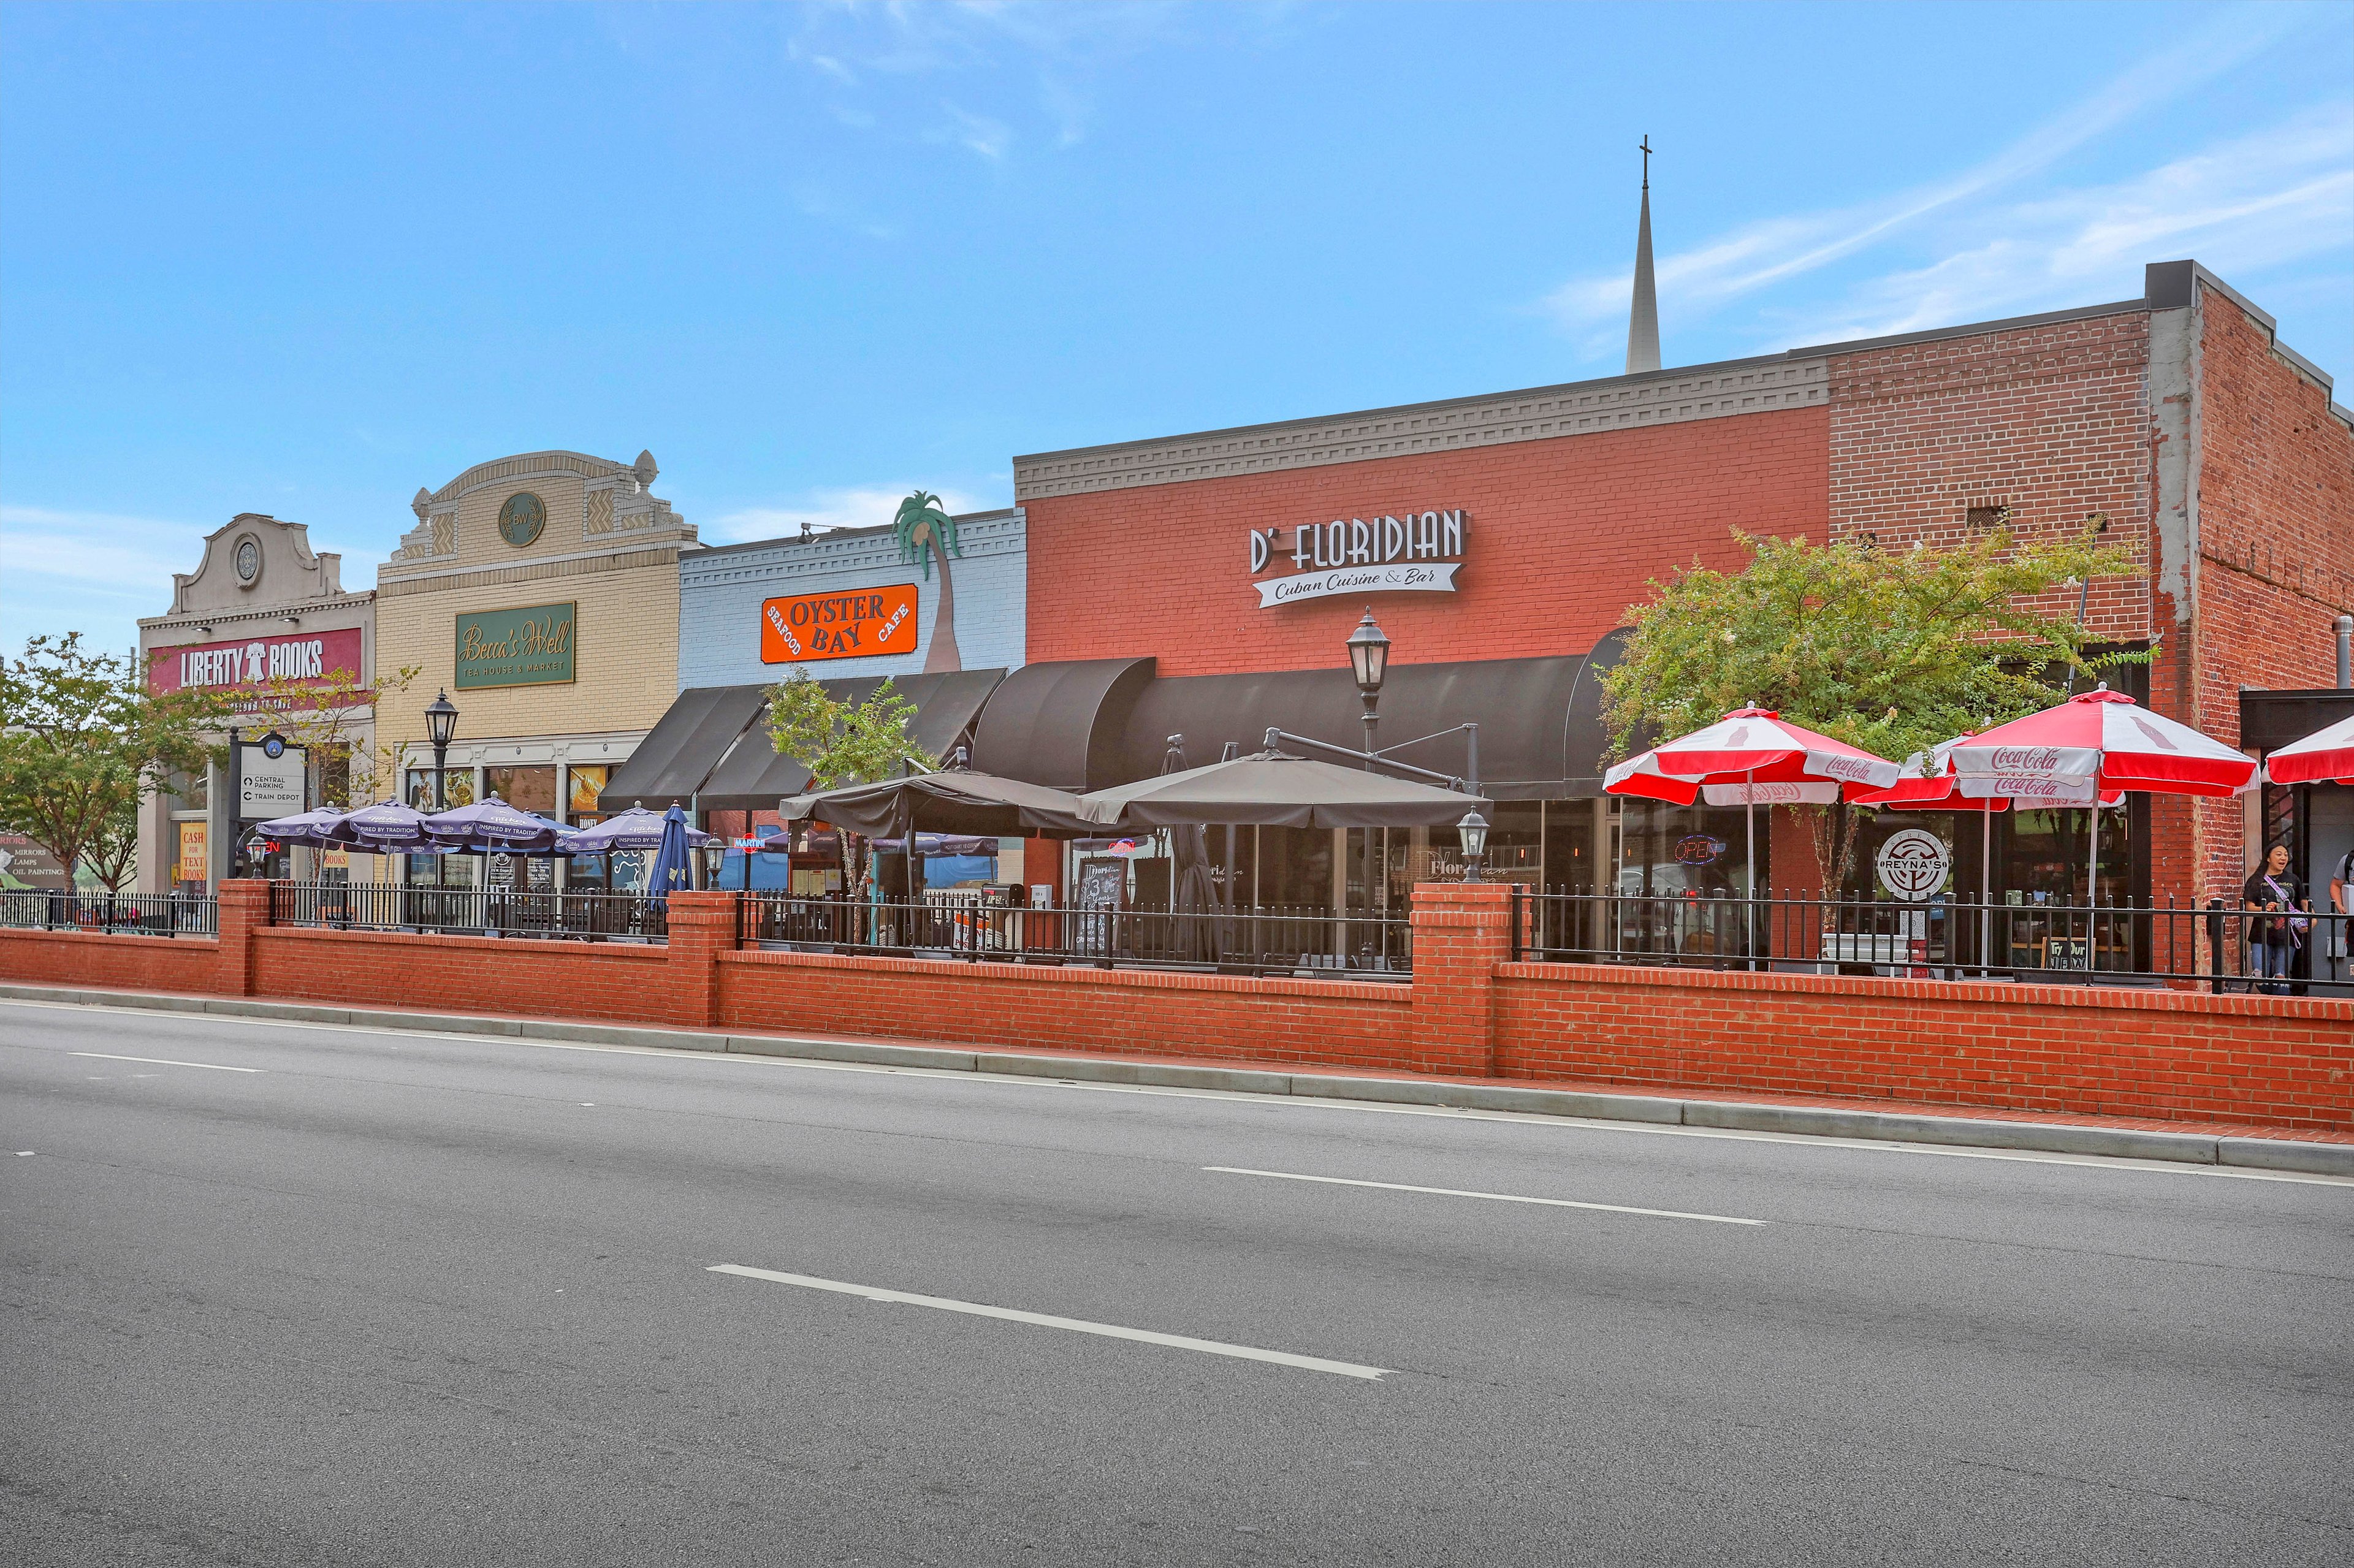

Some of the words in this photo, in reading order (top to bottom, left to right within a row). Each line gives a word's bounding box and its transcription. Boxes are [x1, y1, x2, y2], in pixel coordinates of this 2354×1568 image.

[514, 513, 528, 525] BW
[1290, 509, 1463, 569] FLORIDIAN
[1275, 582, 1323, 599] Cuban
[1327, 573, 1381, 591] Cuisine
[1385, 570, 1402, 583] &
[1404, 568, 1436, 585] Bar
[790, 594, 885, 626] OYSTER
[878, 603, 910, 642] CAFE
[459, 623, 520, 662] Becca's
[522, 615, 571, 656] Well
[767, 606, 802, 656] SEAFOOD
[809, 622, 862, 654] BAY
[181, 647, 245, 688] LIBERTY
[270, 640, 324, 680] BOOKS
[463, 668, 479, 677] TEA
[484, 665, 513, 676] HOUSE
[517, 664, 523, 673] &
[527, 661, 565, 672] MARKET
[479, 824, 503, 832] INSPIRED
[580, 819, 598, 829] HONEY
[735, 839, 766, 847] MARTINI
[1108, 842, 1136, 854] OPEN
[1675, 841, 1717, 859] OPEN
[1884, 833, 1944, 857] ESPRESSO
[184, 857, 204, 867] TEXT
[326, 854, 346, 864] BOOKS
[1885, 861, 1942, 869] REYNA'S
[184, 869, 204, 880] BOOKS
[1090, 880, 1100, 897] 3
[2051, 942, 2063, 956] Try
